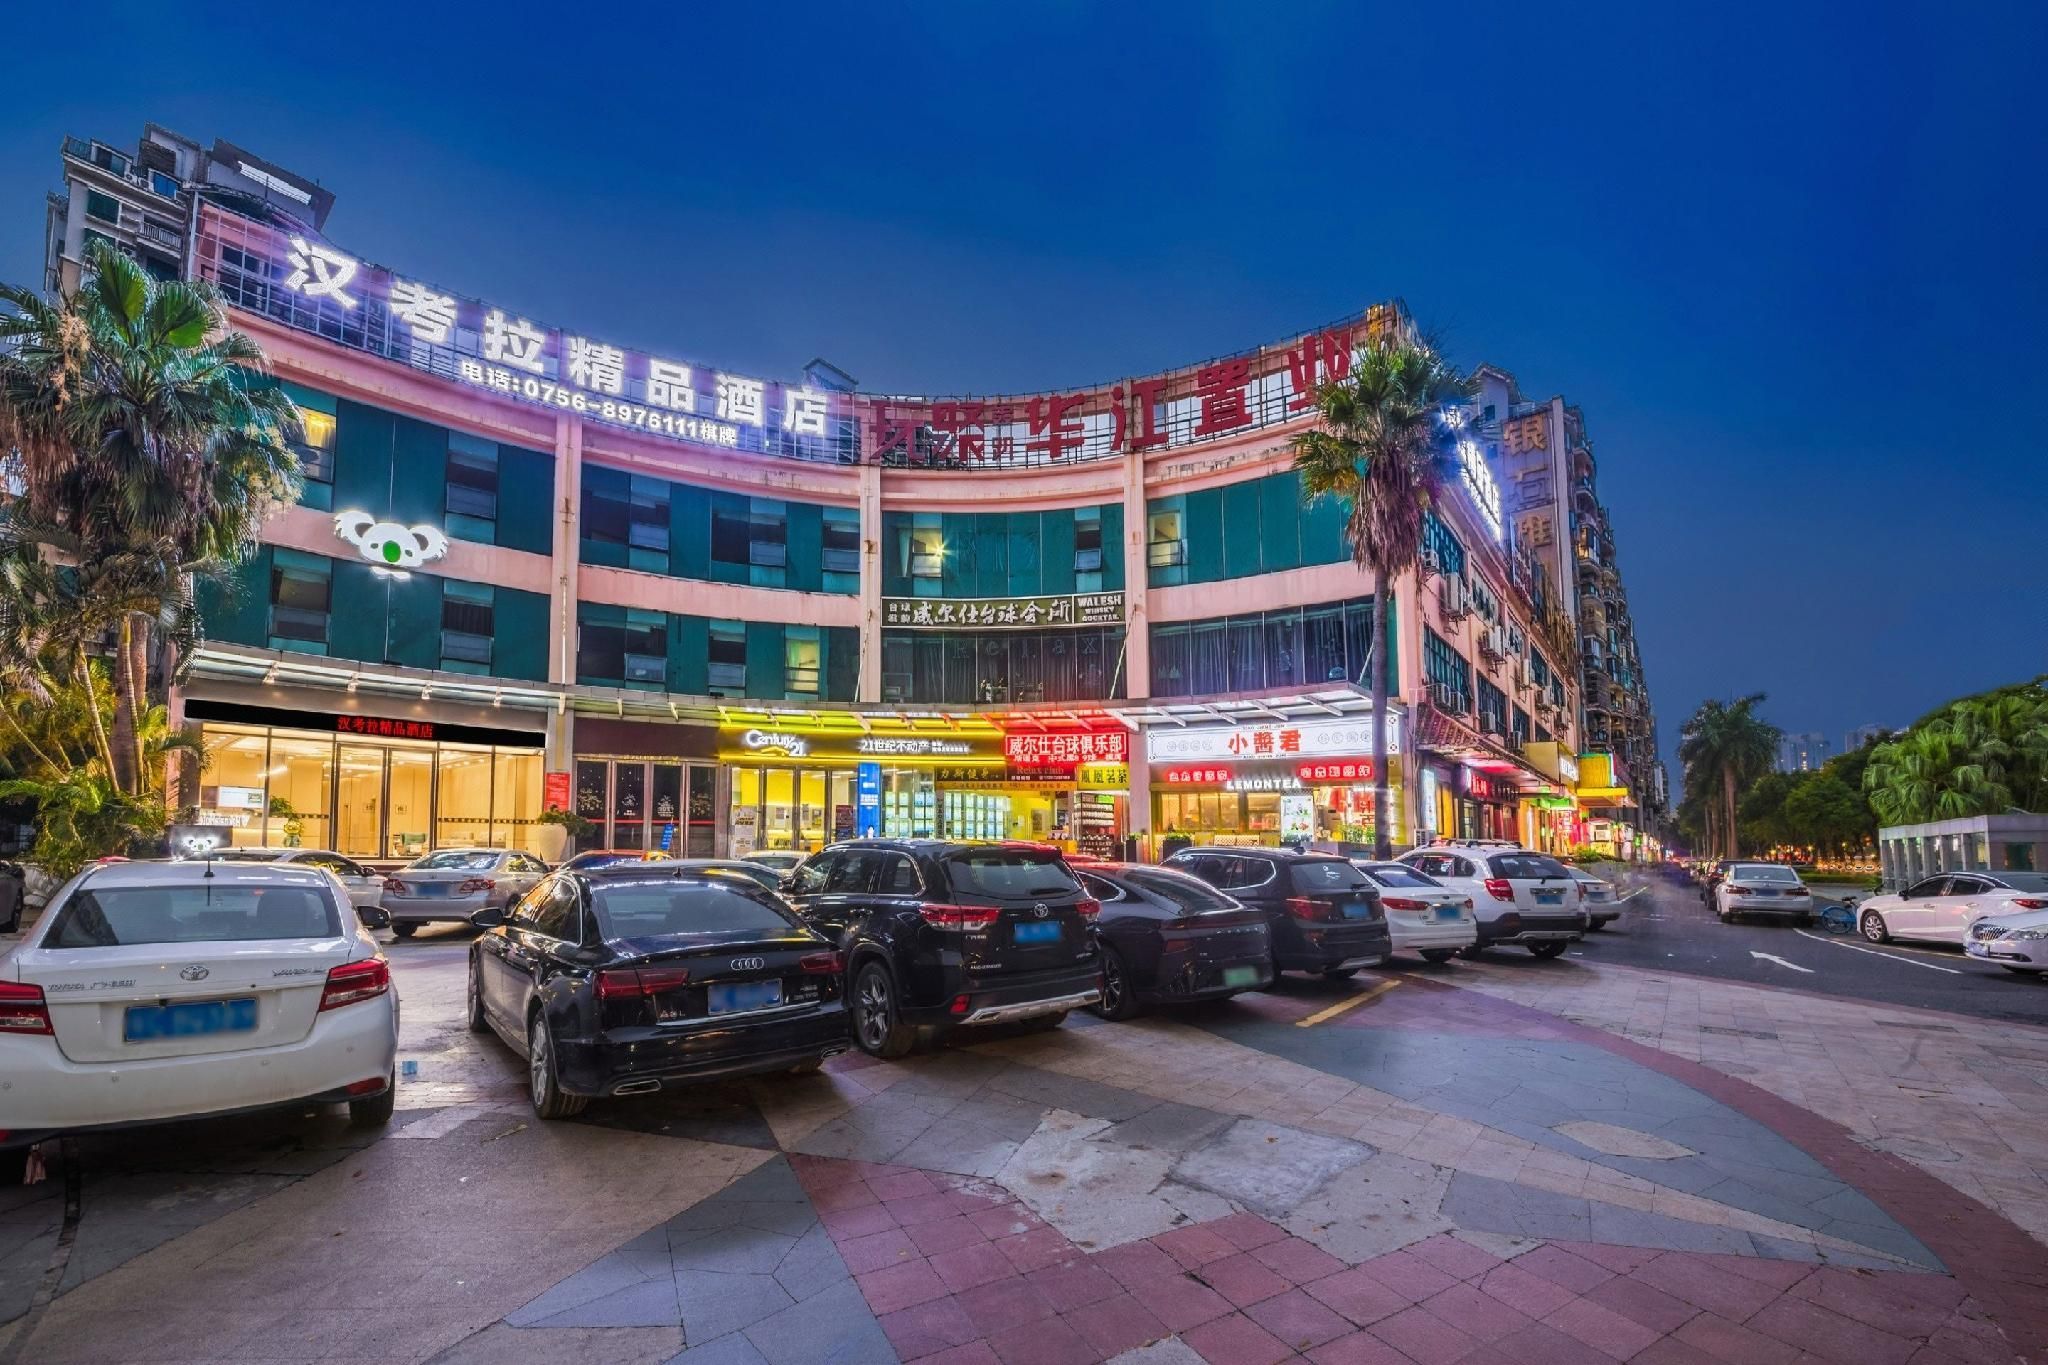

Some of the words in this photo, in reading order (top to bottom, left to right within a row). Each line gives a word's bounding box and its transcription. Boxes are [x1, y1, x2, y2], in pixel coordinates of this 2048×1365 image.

[284, 234, 828, 435] 汉考拉精品酒店
[1077, 594, 1122, 607] WALESH
[337, 716, 433, 738] 汉考拉精品酒店
[859, 738, 930, 753] 21世纪不动产
[1009, 734, 1122, 755] 威尔仕台球俱乐部
